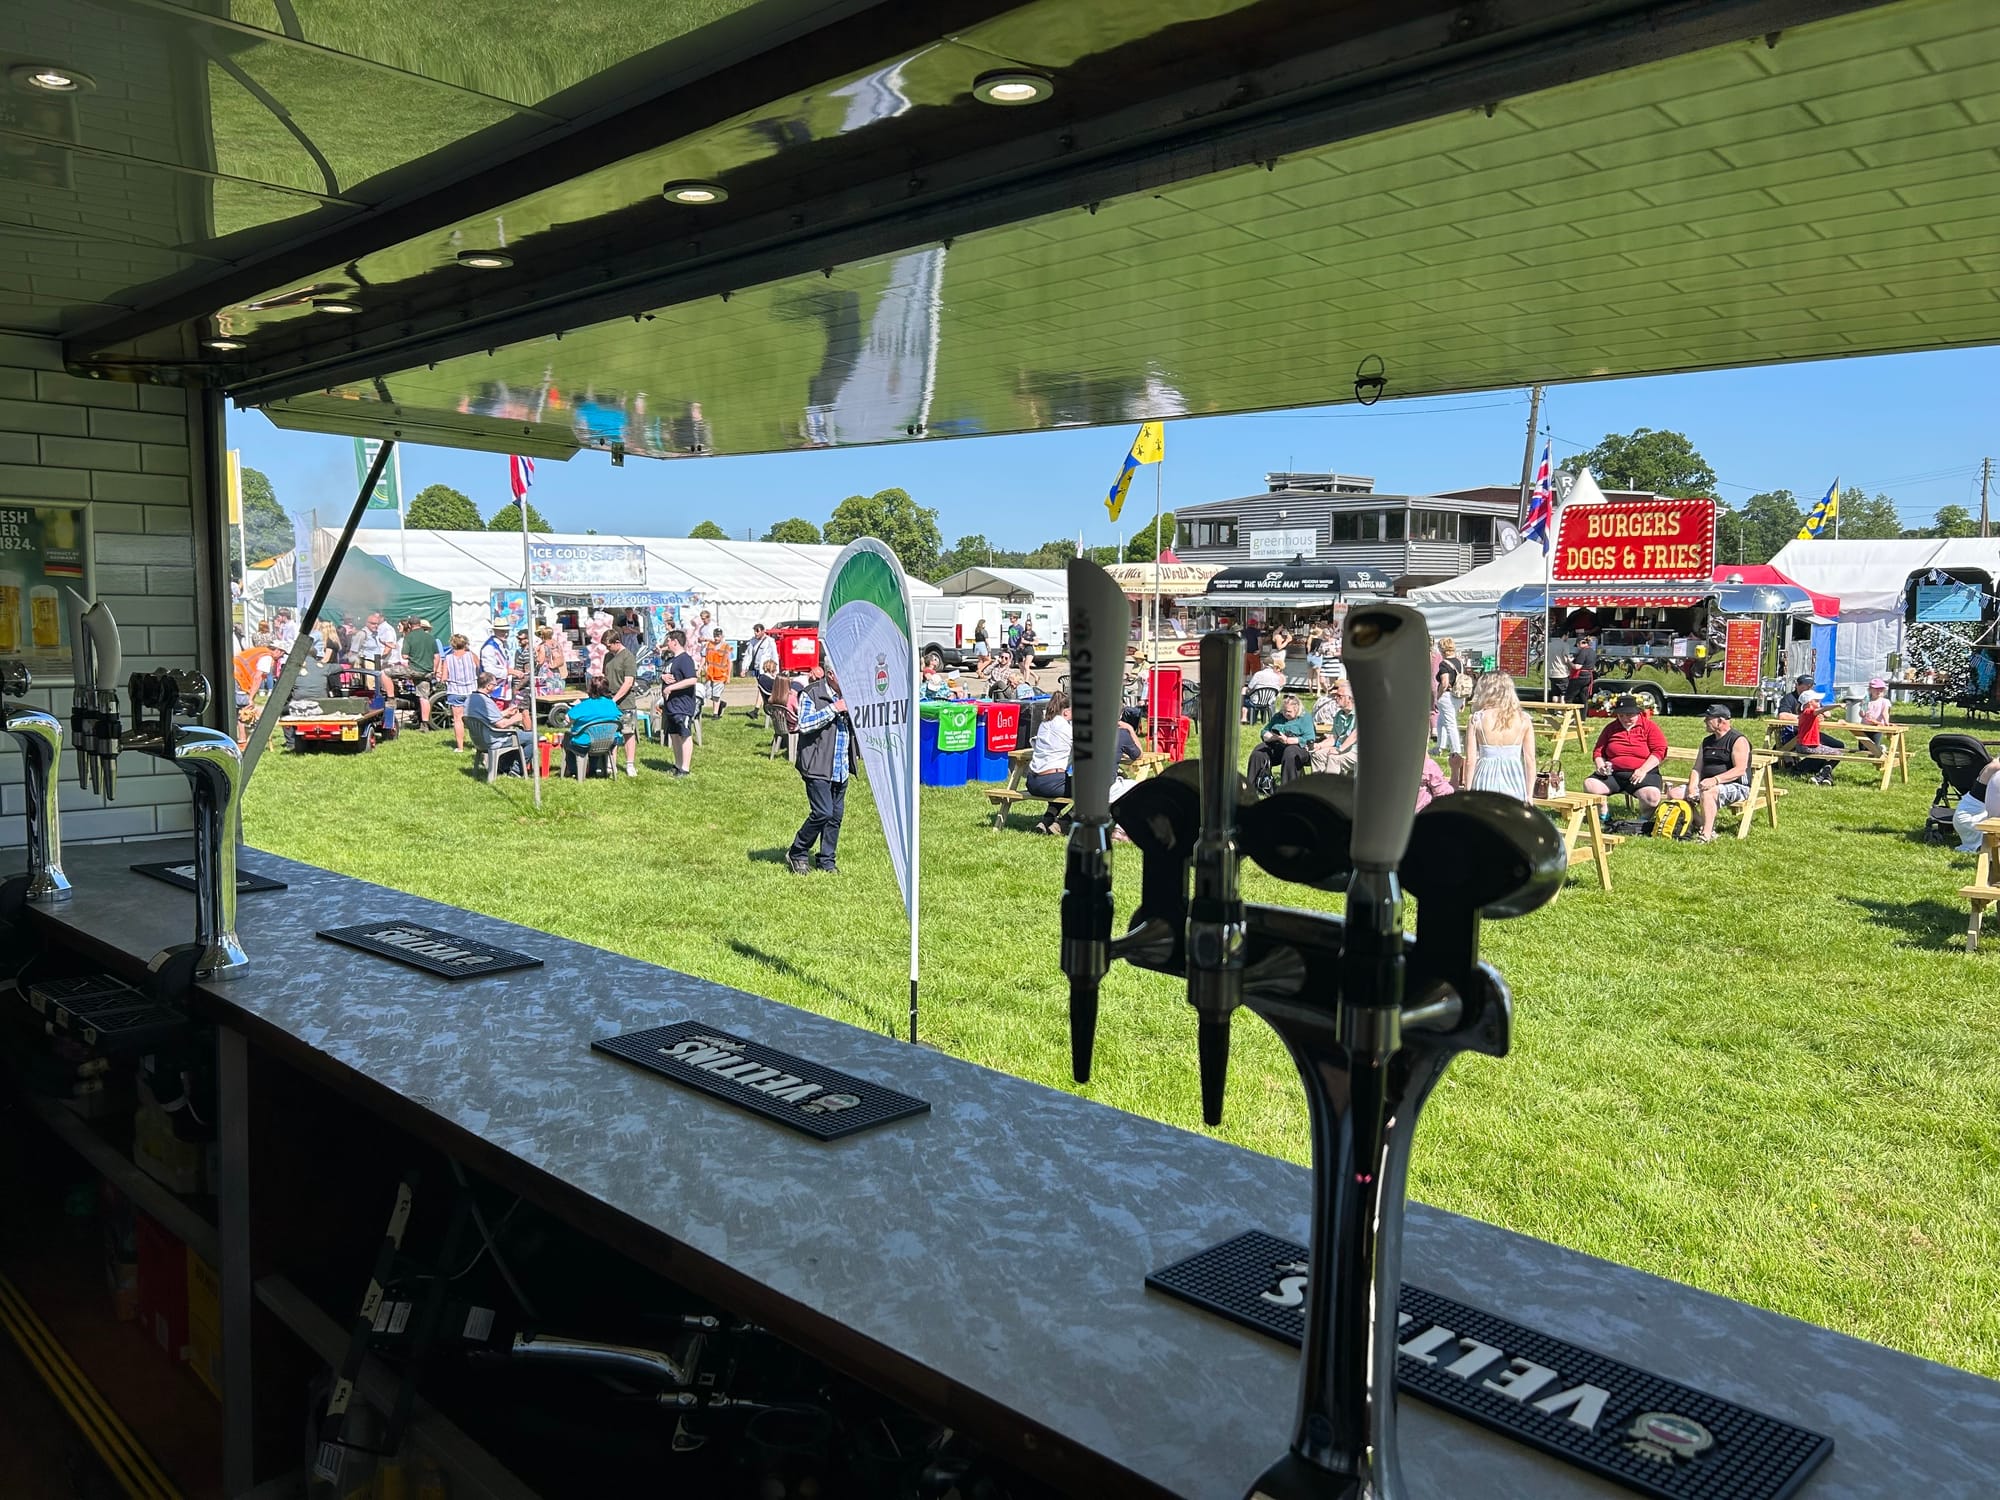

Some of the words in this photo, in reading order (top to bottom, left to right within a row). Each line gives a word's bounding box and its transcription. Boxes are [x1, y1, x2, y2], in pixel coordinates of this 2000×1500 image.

[0, 524, 20, 537] ER
[1587, 511, 1681, 539] BURGERS
[0, 538, 36, 551] 1824.
[1253, 535, 1313, 550] greenhous
[533, 548, 553, 559] ICE
[556, 548, 588, 560] COLD
[1566, 546, 1616, 571] DOGS
[1623, 545, 1636, 570] &
[1642, 543, 1702, 569] FRIES
[1244, 580, 1257, 589] THE
[1256, 579, 1281, 589] WAFFLE
[1282, 580, 1300, 589] MAN
[624, 594, 649, 605] COLD
[1072, 648, 1094, 762] VELTINS
[656, 1041, 824, 1104] VELTINS
[1259, 1274, 1611, 1433] VELTS
